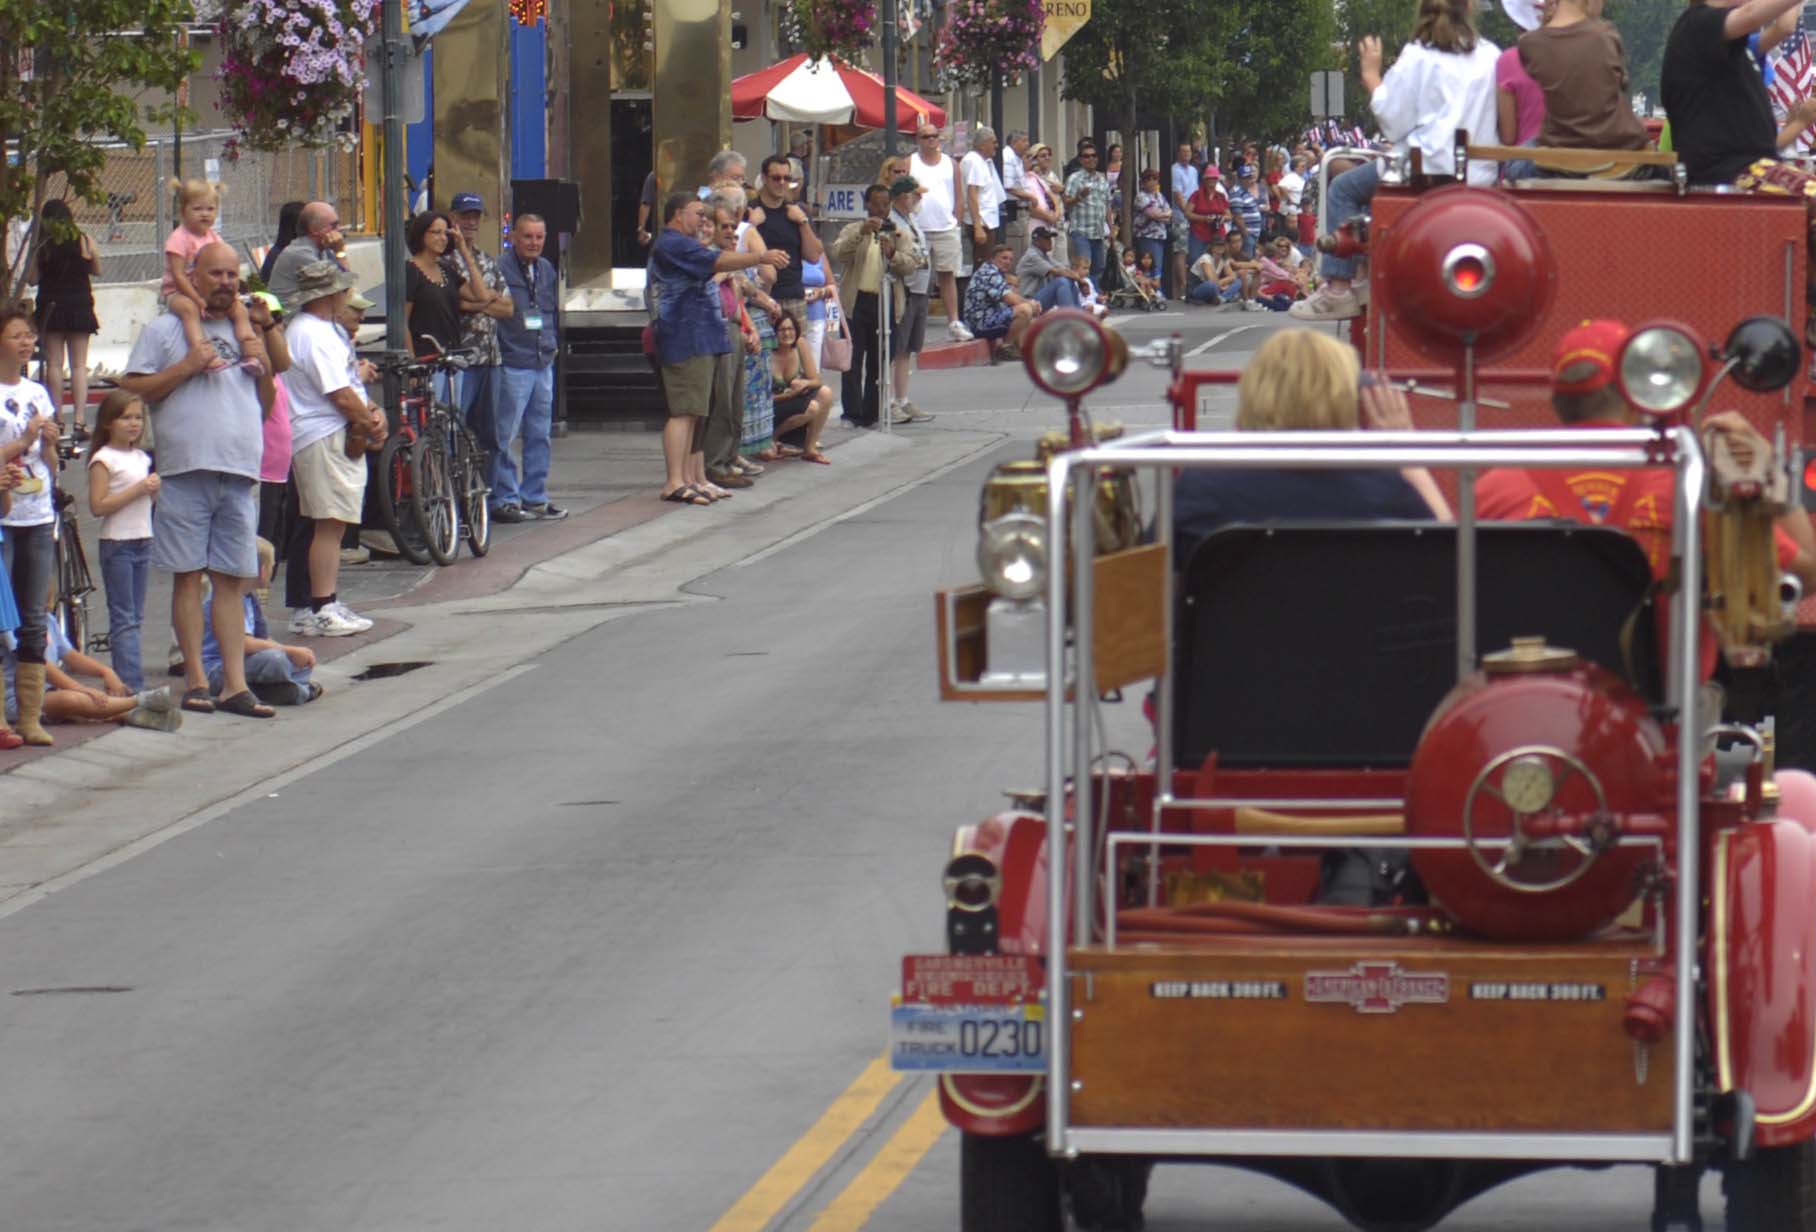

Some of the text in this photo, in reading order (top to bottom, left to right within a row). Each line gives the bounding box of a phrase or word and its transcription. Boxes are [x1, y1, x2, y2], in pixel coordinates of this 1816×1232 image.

[1046, 1, 1087, 17] RENO
[906, 981, 953, 996] FIRE
[960, 1019, 1041, 1058] 0230
[899, 1041, 957, 1055] TRUCK
